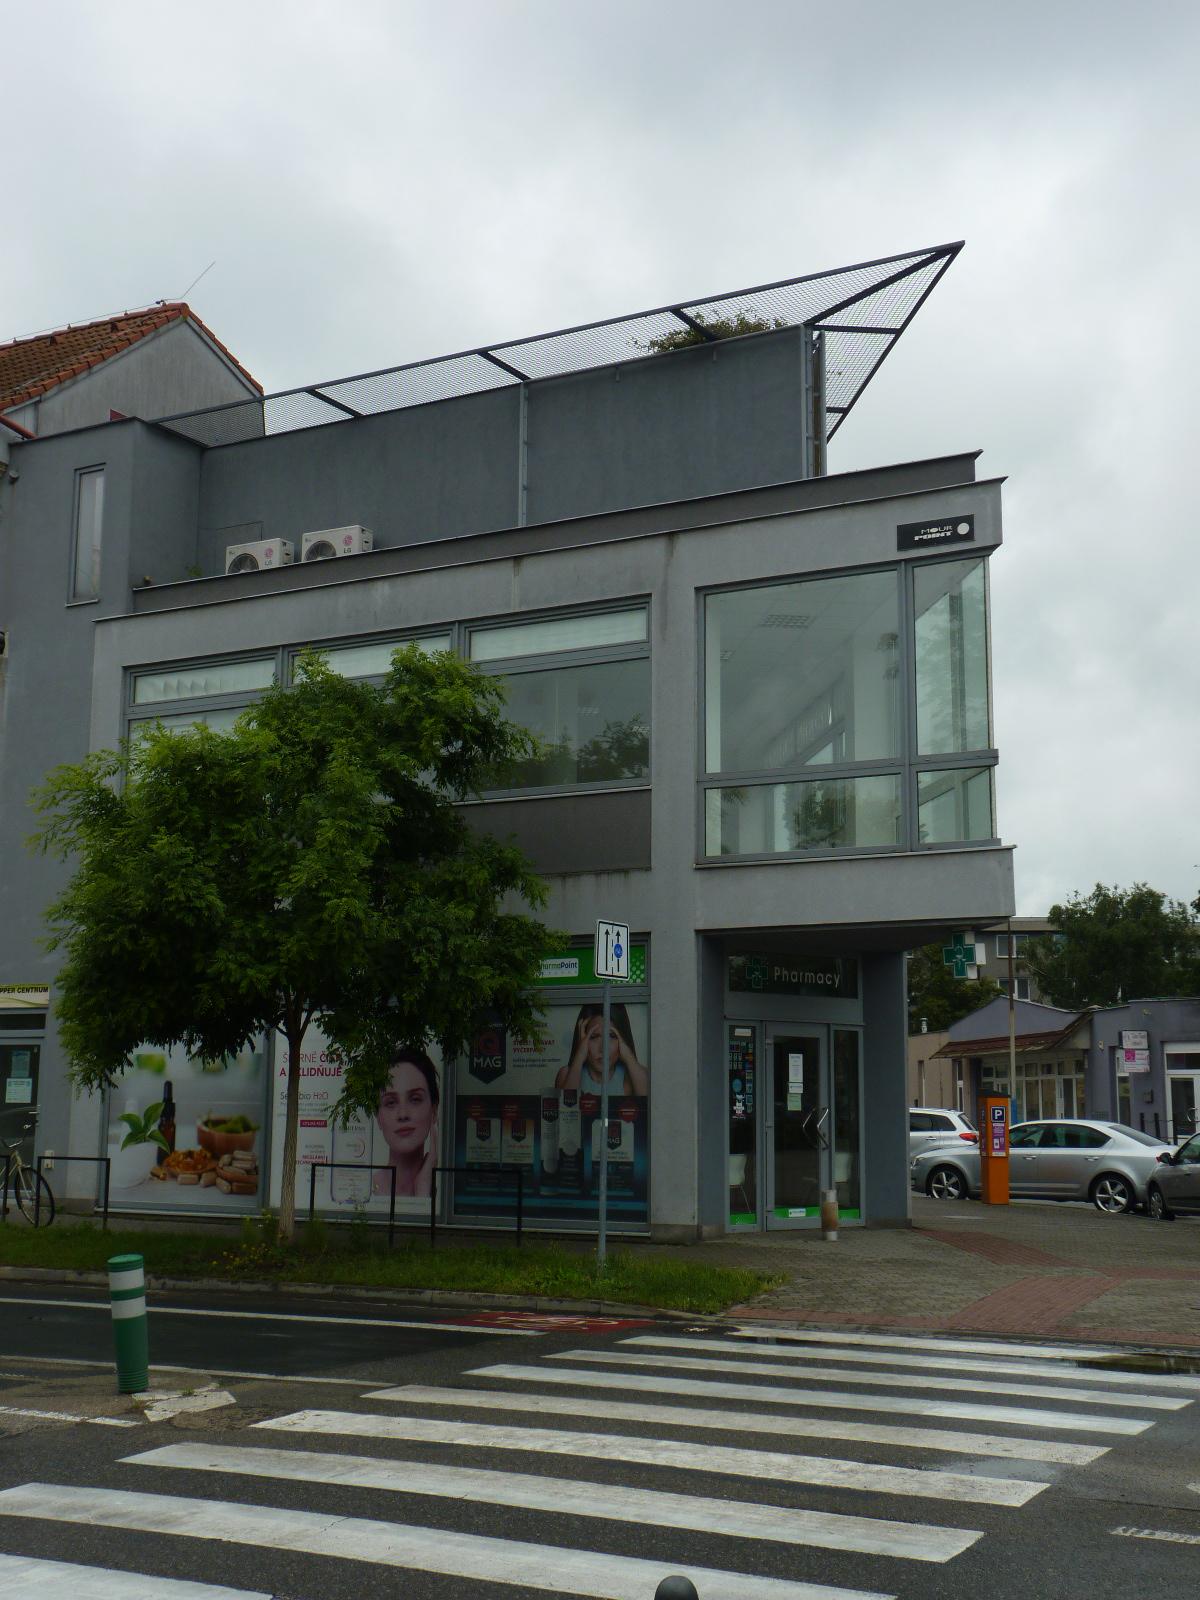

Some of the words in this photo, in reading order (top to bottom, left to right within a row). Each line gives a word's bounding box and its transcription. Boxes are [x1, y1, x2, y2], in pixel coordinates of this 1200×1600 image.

[921, 525, 953, 534] MOUR
[914, 531, 953, 541] POINT
[774, 966, 841, 989] Pharmacy
[474, 1056, 502, 1068] MAG
[280, 1067, 287, 1077] A
[994, 1109, 1003, 1120] P
